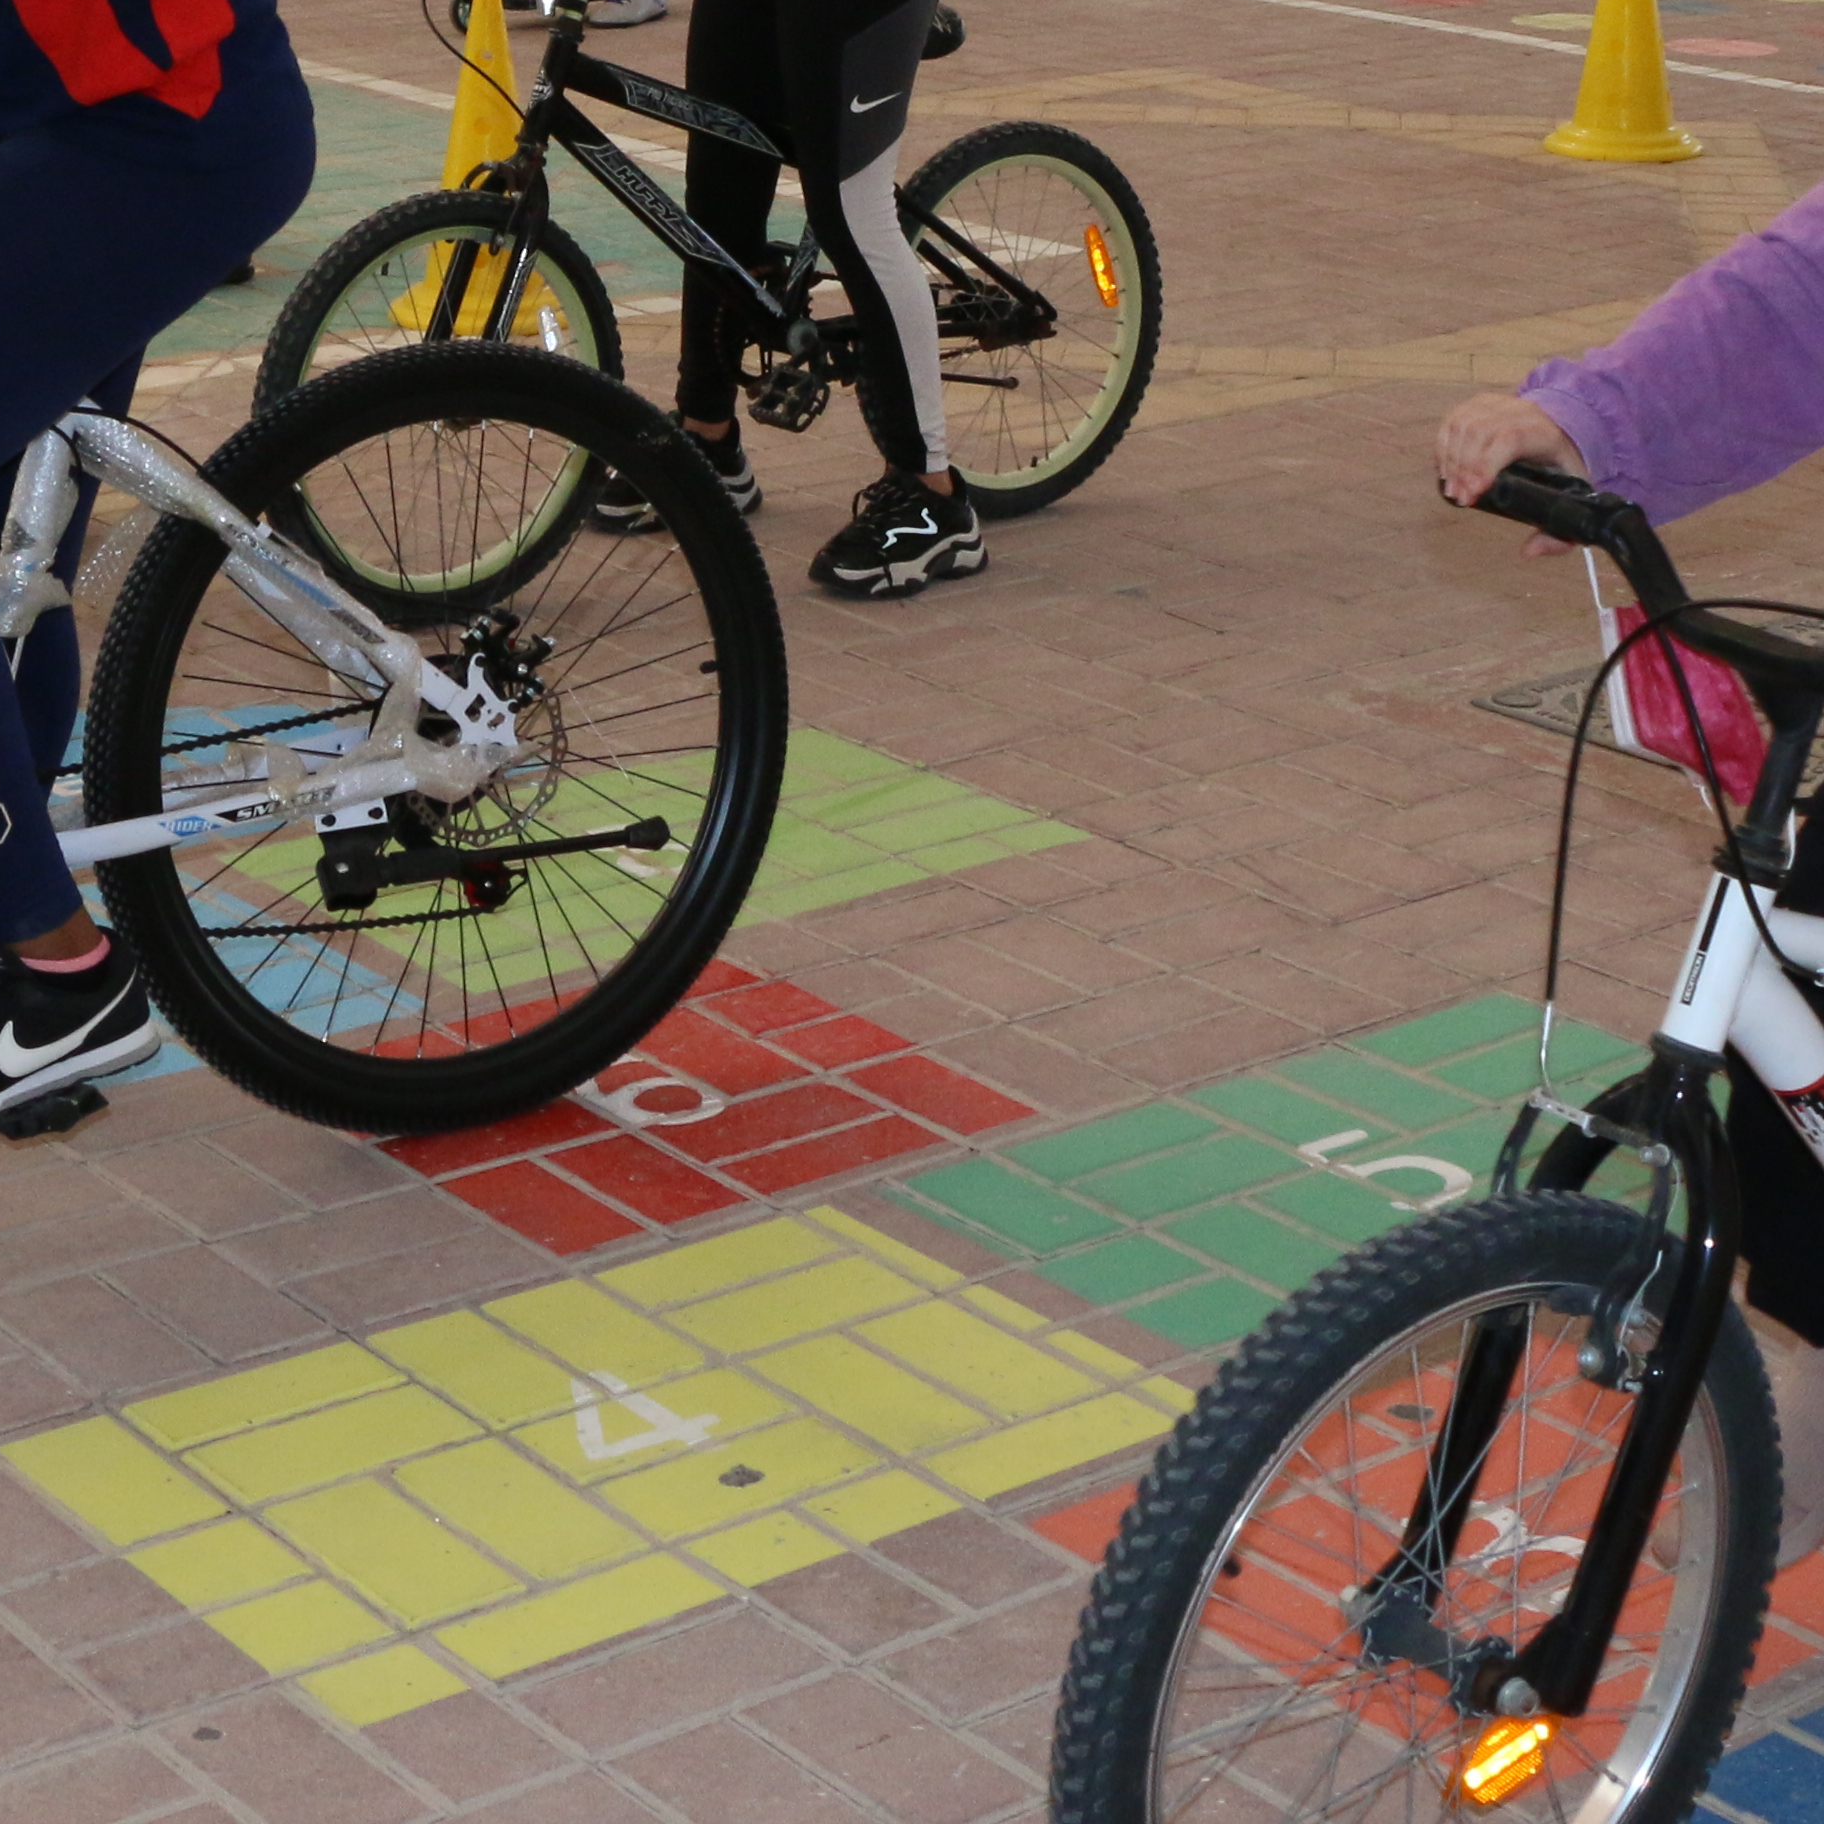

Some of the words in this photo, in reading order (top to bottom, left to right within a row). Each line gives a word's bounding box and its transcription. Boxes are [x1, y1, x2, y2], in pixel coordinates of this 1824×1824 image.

[615, 164, 681, 223] HUFFY
[1297, 1129, 1474, 1214] 5
[572, 1368, 723, 1462] 4
